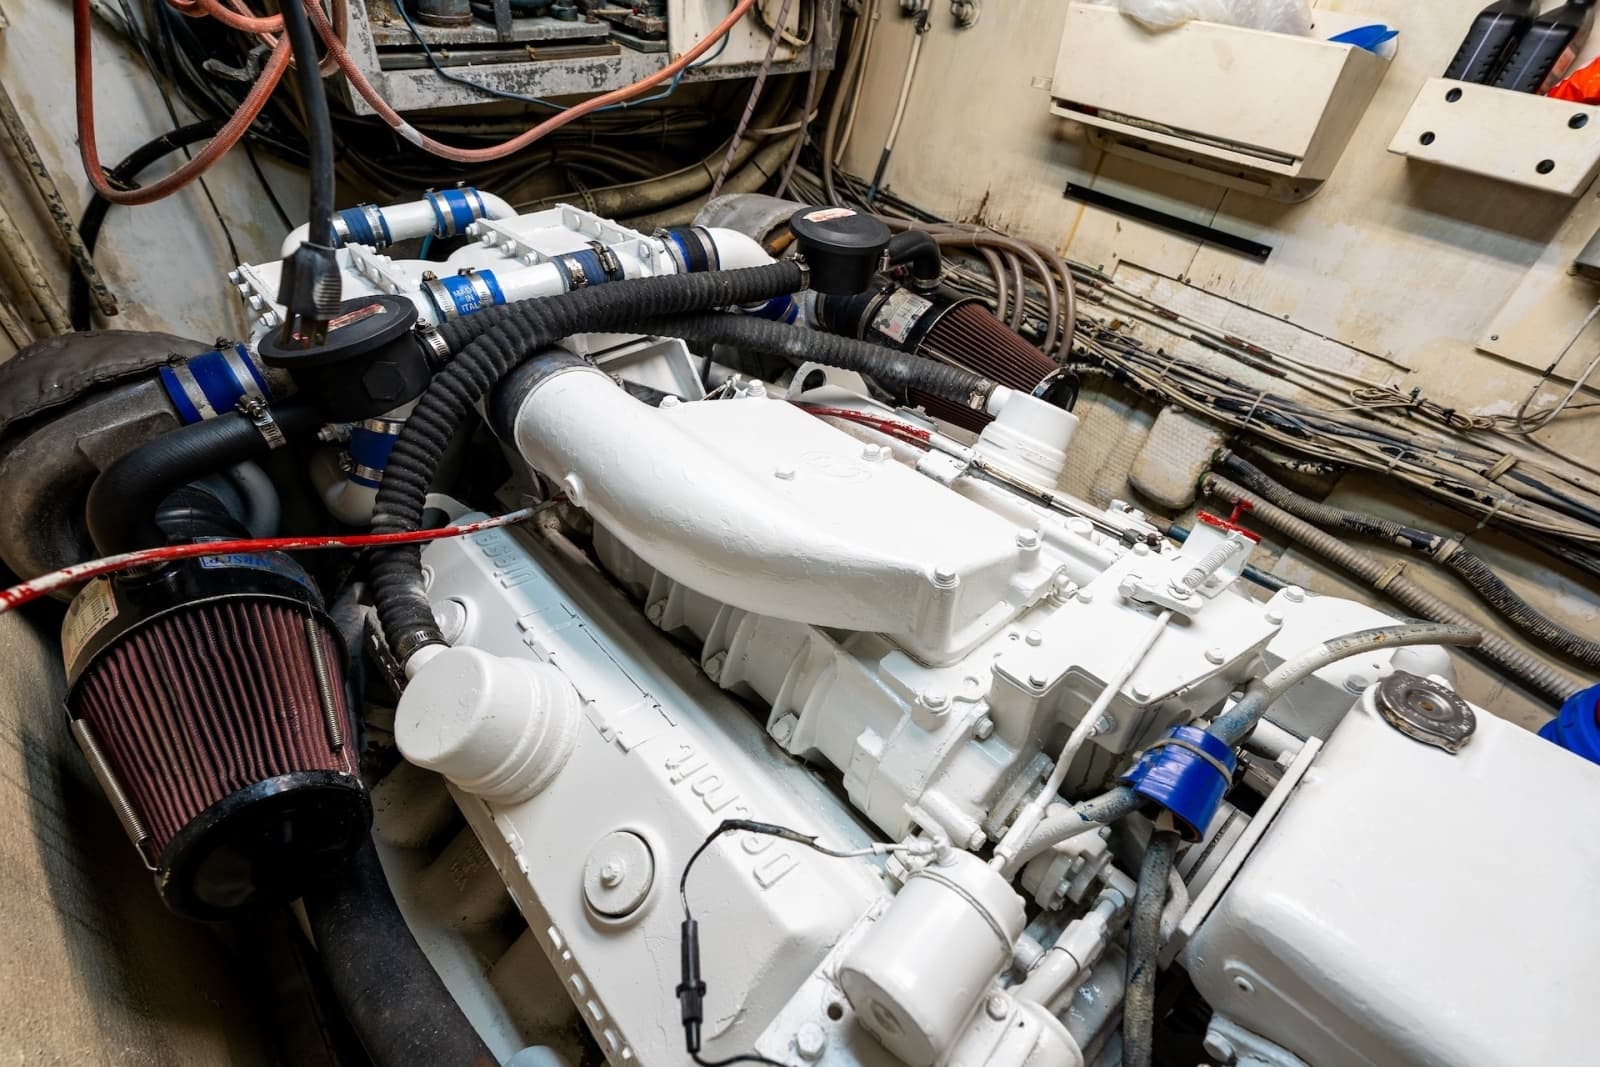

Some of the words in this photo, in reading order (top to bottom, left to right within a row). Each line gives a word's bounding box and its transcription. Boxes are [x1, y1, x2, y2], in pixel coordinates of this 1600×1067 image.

[453, 286, 475, 297] MAD
[464, 293, 475, 302] IN
[474, 529, 537, 588] Diese
